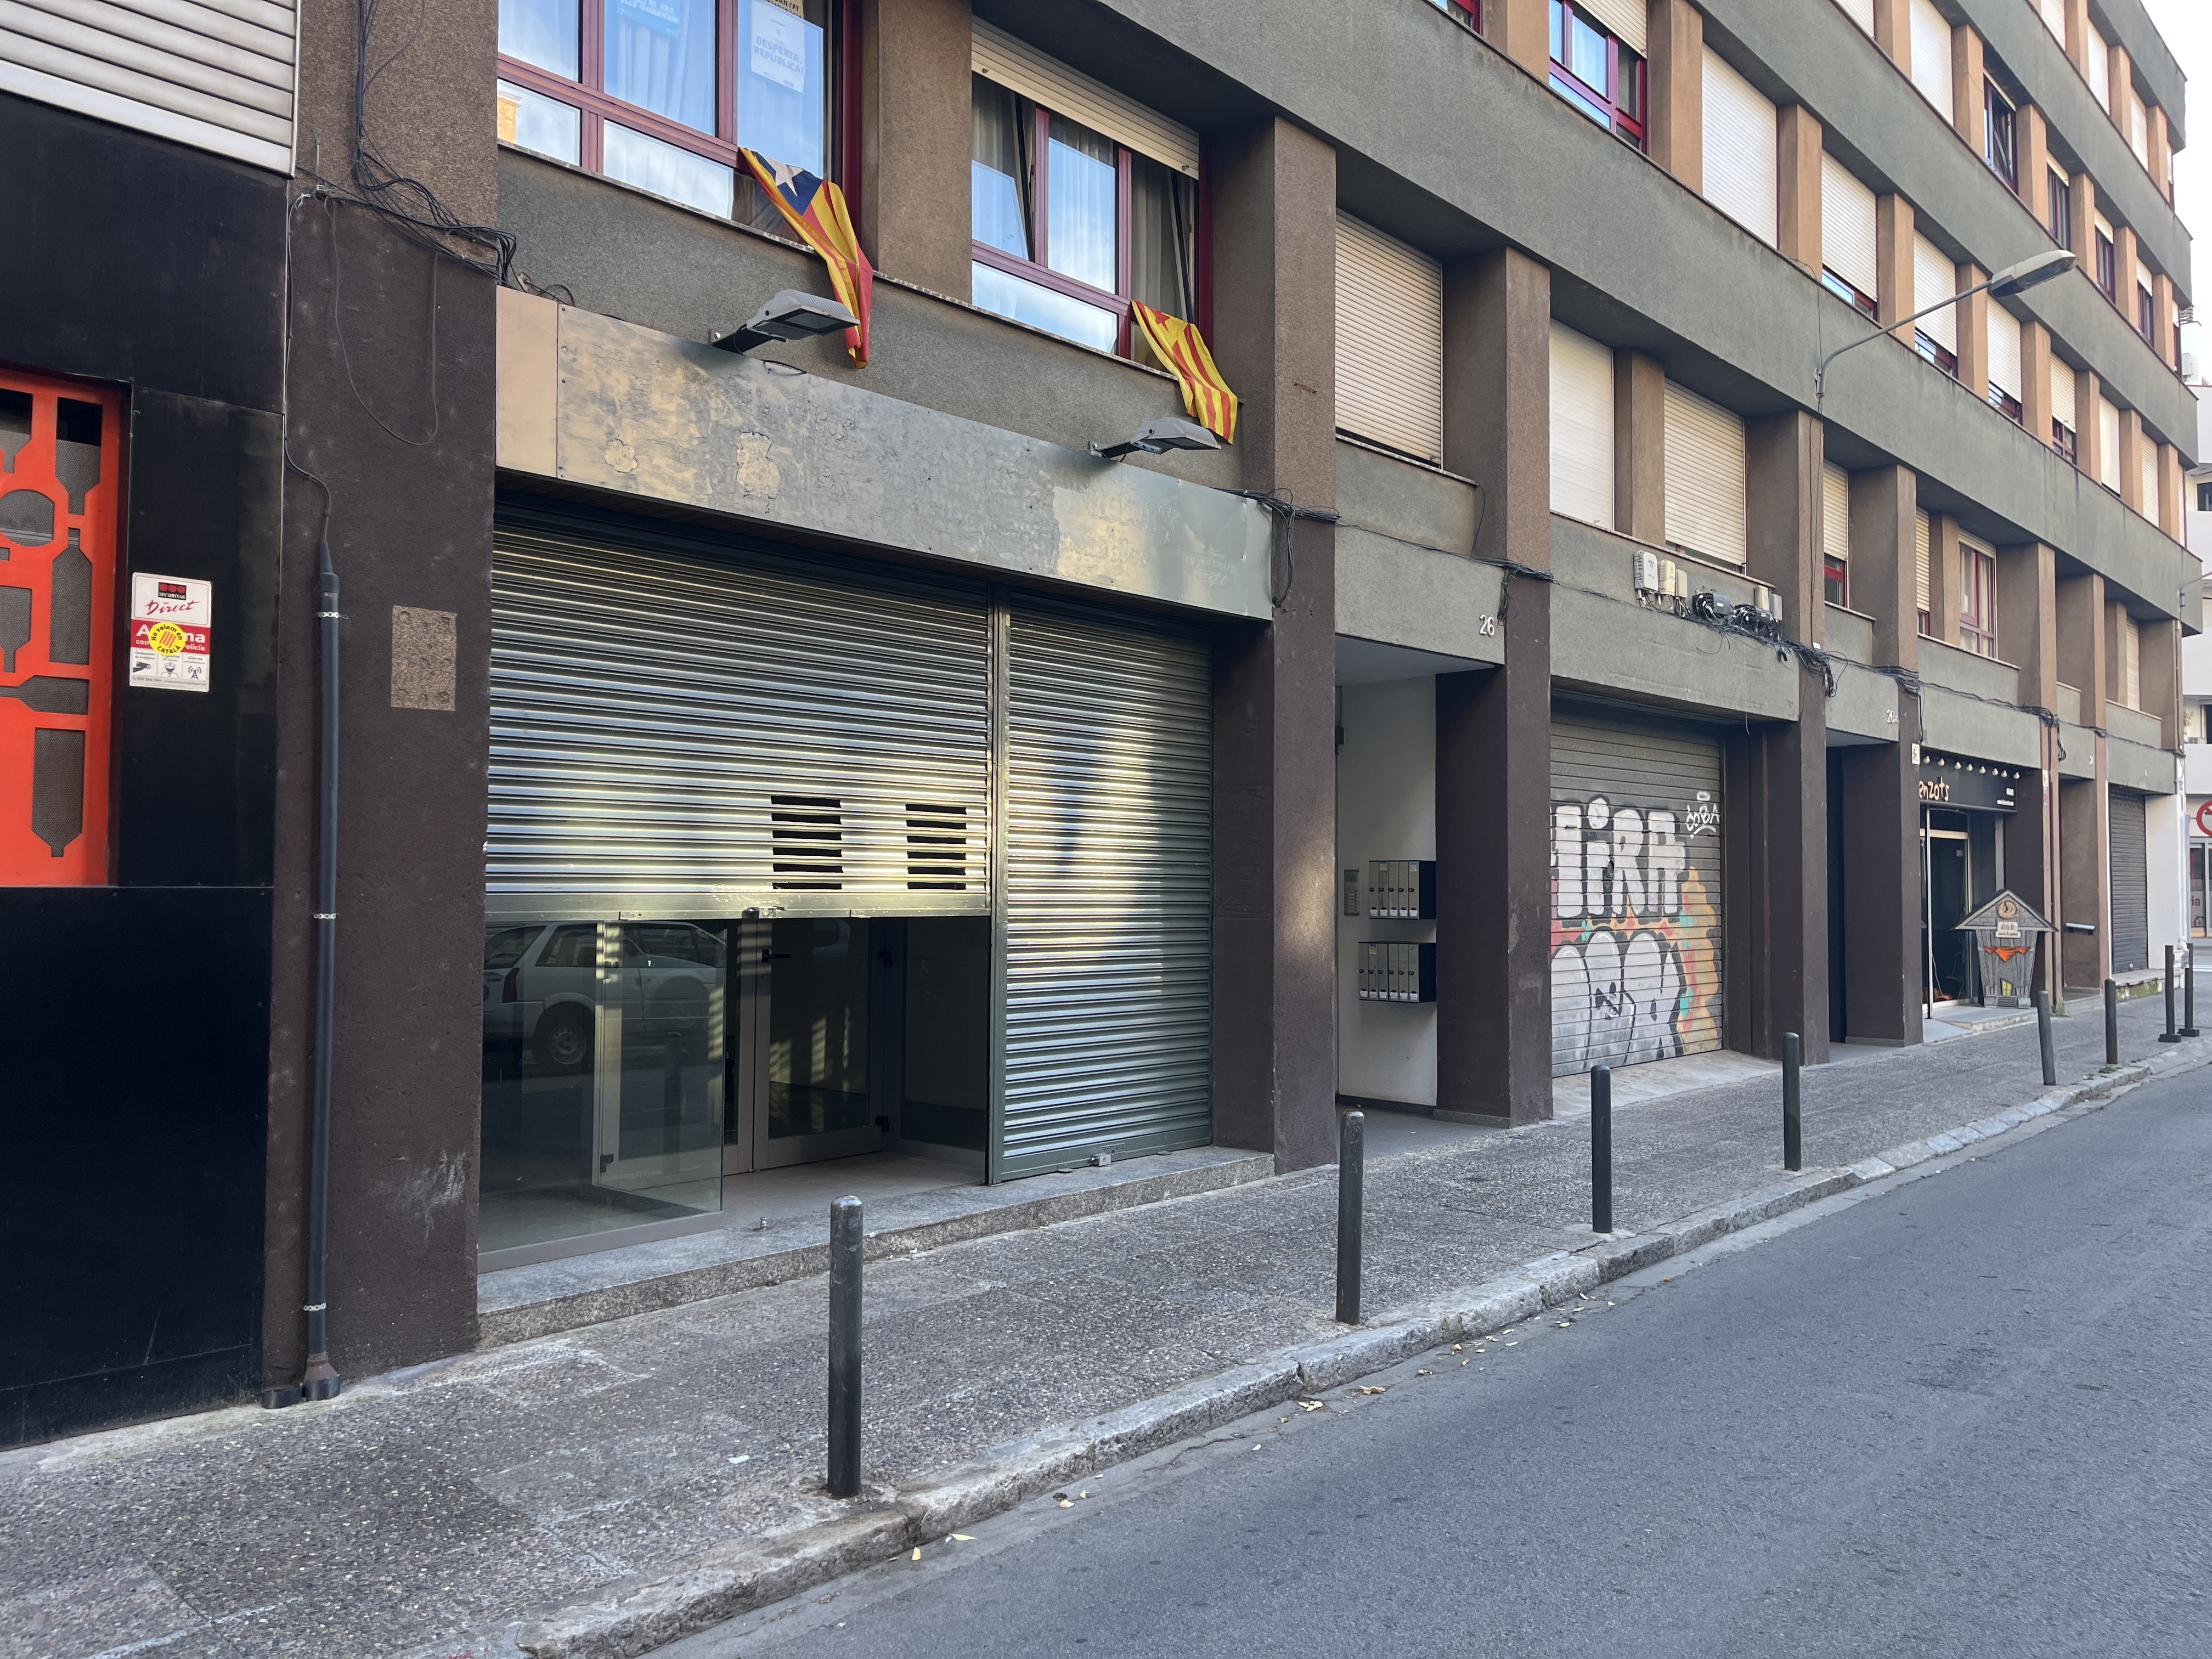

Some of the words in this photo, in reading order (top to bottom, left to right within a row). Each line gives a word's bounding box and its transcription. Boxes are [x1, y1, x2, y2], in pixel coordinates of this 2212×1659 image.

[145, 600, 200, 615] Direct
[151, 632, 157, 641] Ho
[155, 624, 177, 633] volem
[1479, 614, 1495, 636] 26
